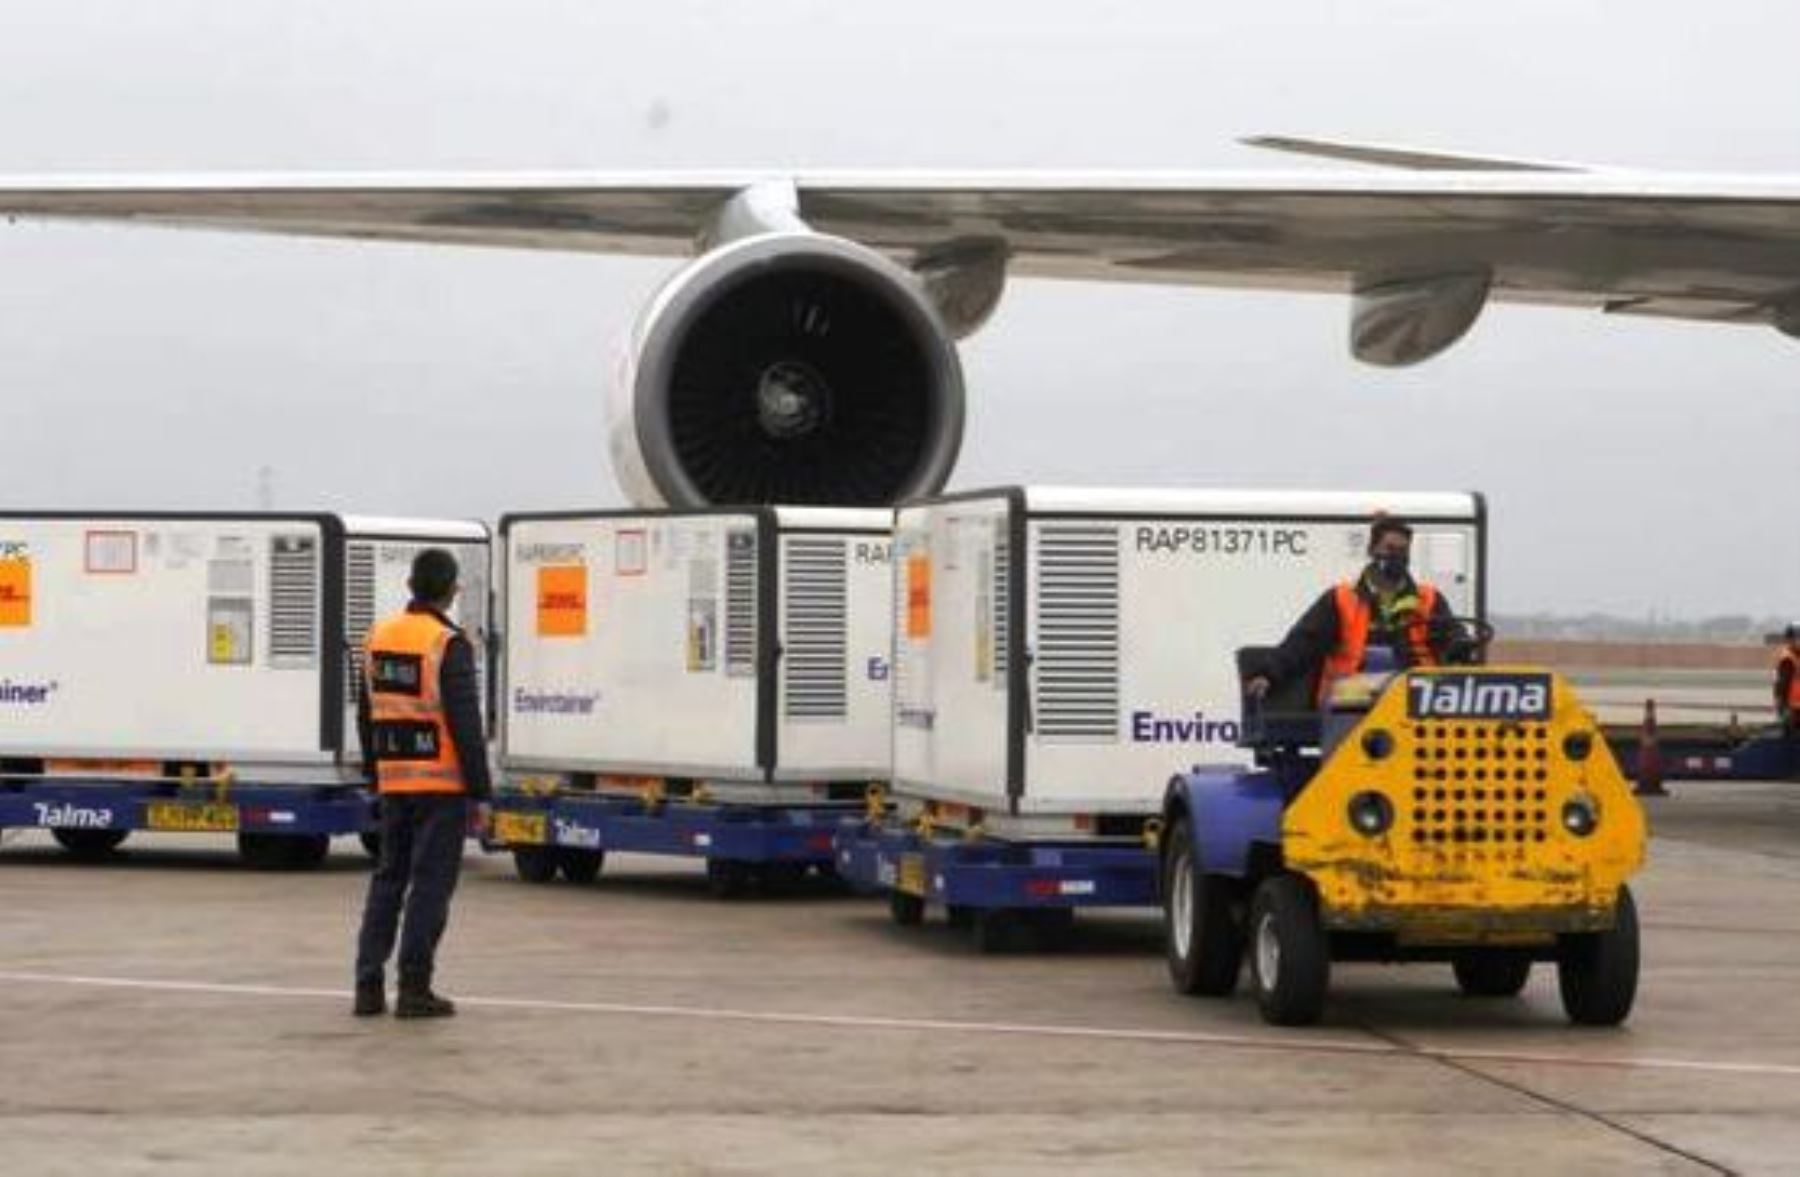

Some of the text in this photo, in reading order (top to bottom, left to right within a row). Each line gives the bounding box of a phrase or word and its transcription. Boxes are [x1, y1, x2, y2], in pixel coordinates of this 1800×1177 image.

[1136, 528, 1308, 554] RAP81371PC
[1410, 677, 1547, 715] Talma
[34, 802, 112, 828] Talma
